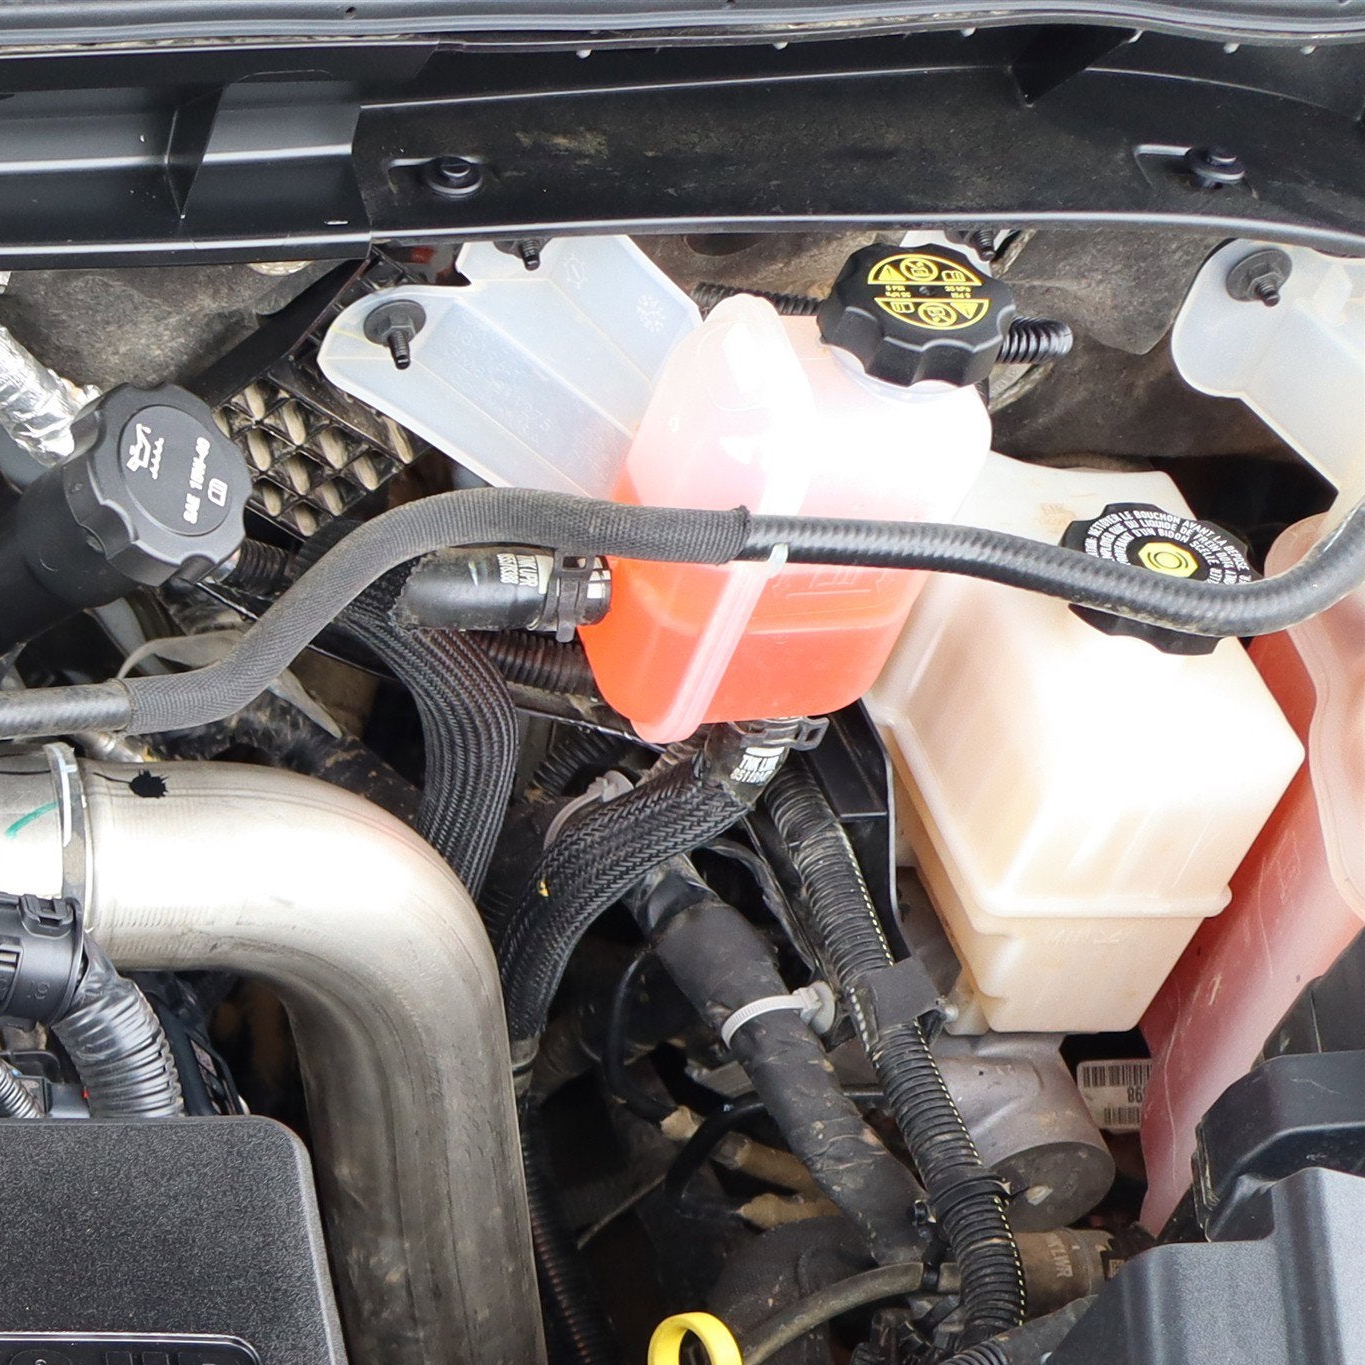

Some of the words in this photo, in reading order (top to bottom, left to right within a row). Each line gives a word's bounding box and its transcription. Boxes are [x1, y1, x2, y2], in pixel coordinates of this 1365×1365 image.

[1119, 511, 1134, 521] LE
[1133, 510, 1181, 526] BOUCHON
[1182, 520, 1216, 540] AVANT
[1213, 535, 1228, 549] LA
[1125, 520, 1139, 530] DU
[1140, 519, 1176, 532] LIQUIDE
[1179, 525, 1194, 537] DE
[1194, 532, 1221, 552] FREIN
[1158, 529, 1191, 544] BIDON
